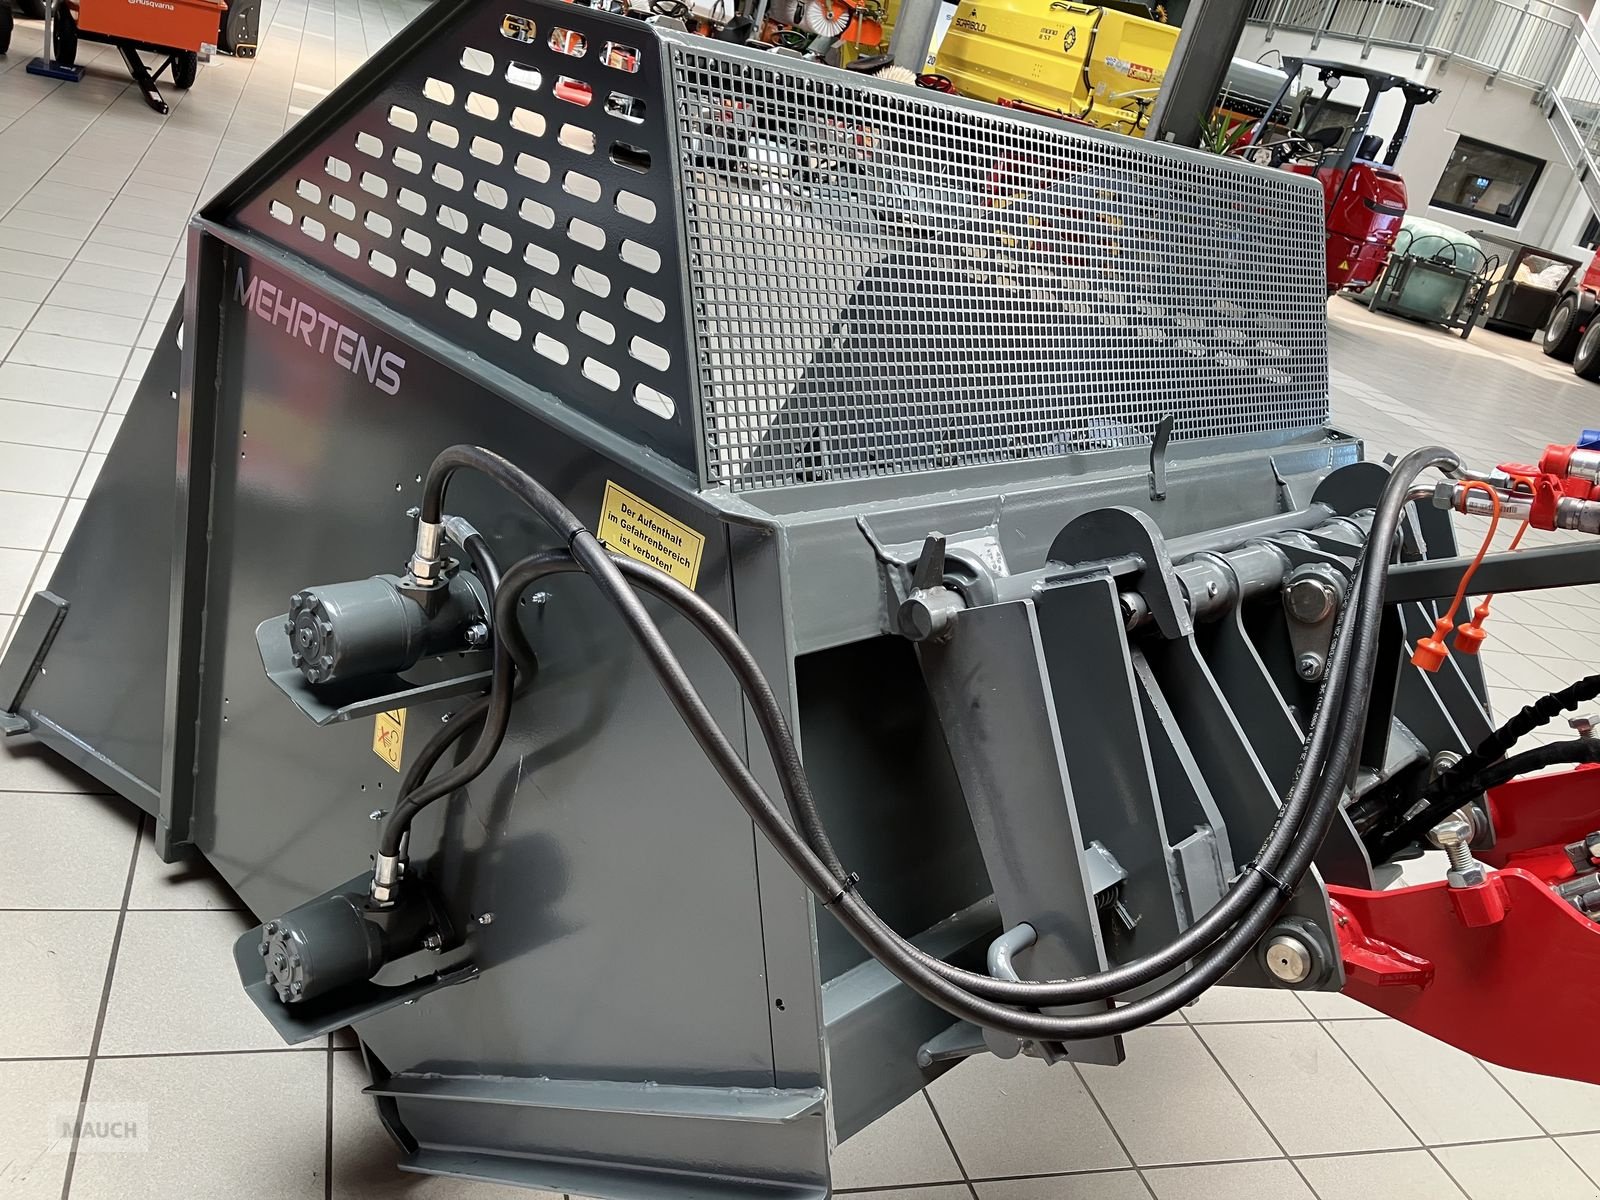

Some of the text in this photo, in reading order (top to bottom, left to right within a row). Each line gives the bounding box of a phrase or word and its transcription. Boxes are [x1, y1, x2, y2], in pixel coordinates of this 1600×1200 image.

[233, 267, 406, 395] MEHRTENS
[607, 511, 691, 568] im Gefahrenbereich
[621, 503, 682, 547] Der Aufenthalt
[619, 534, 672, 573] ist verboten!
